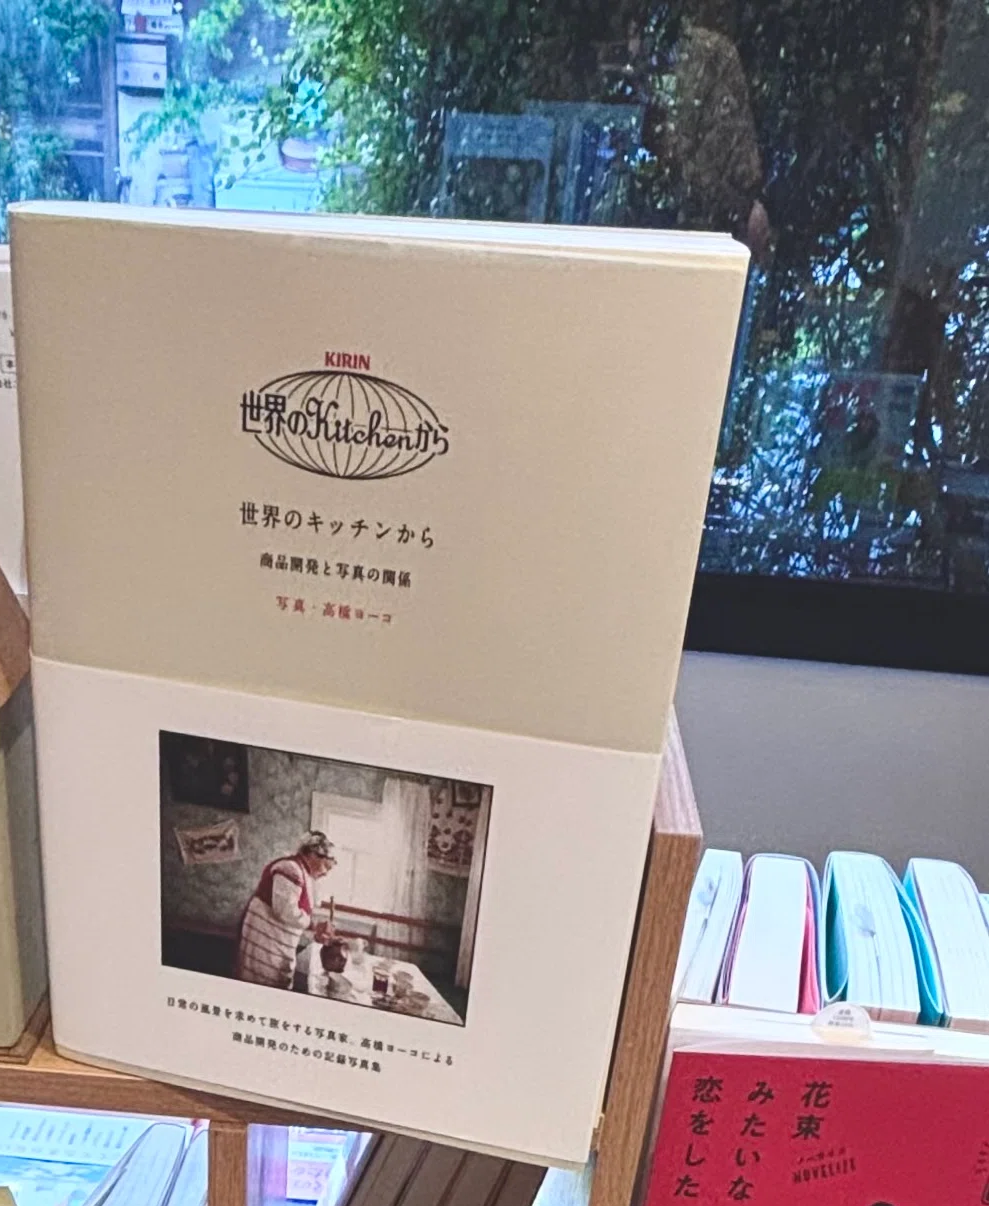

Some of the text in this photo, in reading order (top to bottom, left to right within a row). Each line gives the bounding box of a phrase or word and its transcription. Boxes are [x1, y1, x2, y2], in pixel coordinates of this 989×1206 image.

[324, 351, 371, 371] KIRIN
[239, 389, 450, 456] 世界のKitchenから
[238, 500, 436, 550] 世界のキッチンから
[259, 552, 413, 589] 商品開発と写真の関係
[673, 1076, 724, 1199] 恋をした
[727, 1080, 775, 1201] みたいな
